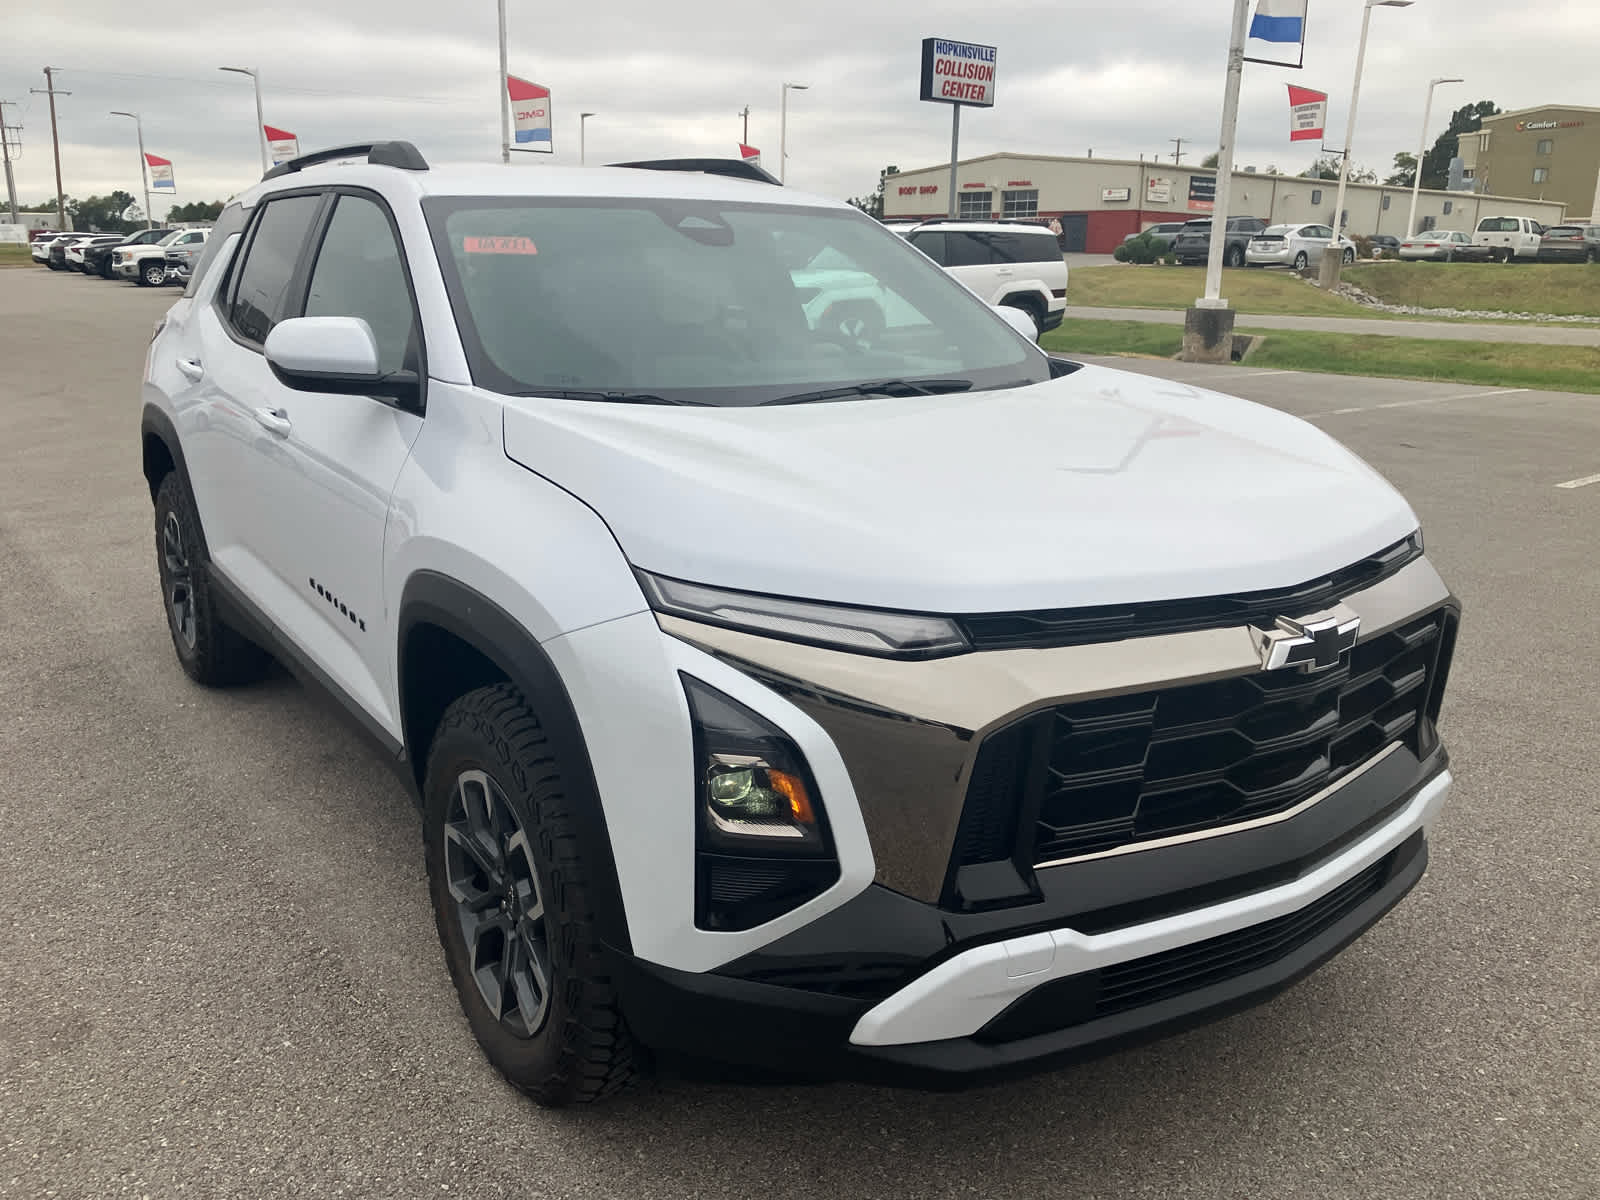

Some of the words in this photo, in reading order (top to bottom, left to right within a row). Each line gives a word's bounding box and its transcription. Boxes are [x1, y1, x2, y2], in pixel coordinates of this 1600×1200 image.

[936, 41, 995, 62] HOPKINSVILLE
[935, 58, 994, 82] COLLISION
[942, 80, 985, 101] CENTER
[1526, 121, 1557, 129] Comfort
[898, 186, 917, 196] BODY
[919, 185, 938, 195] SHOP
